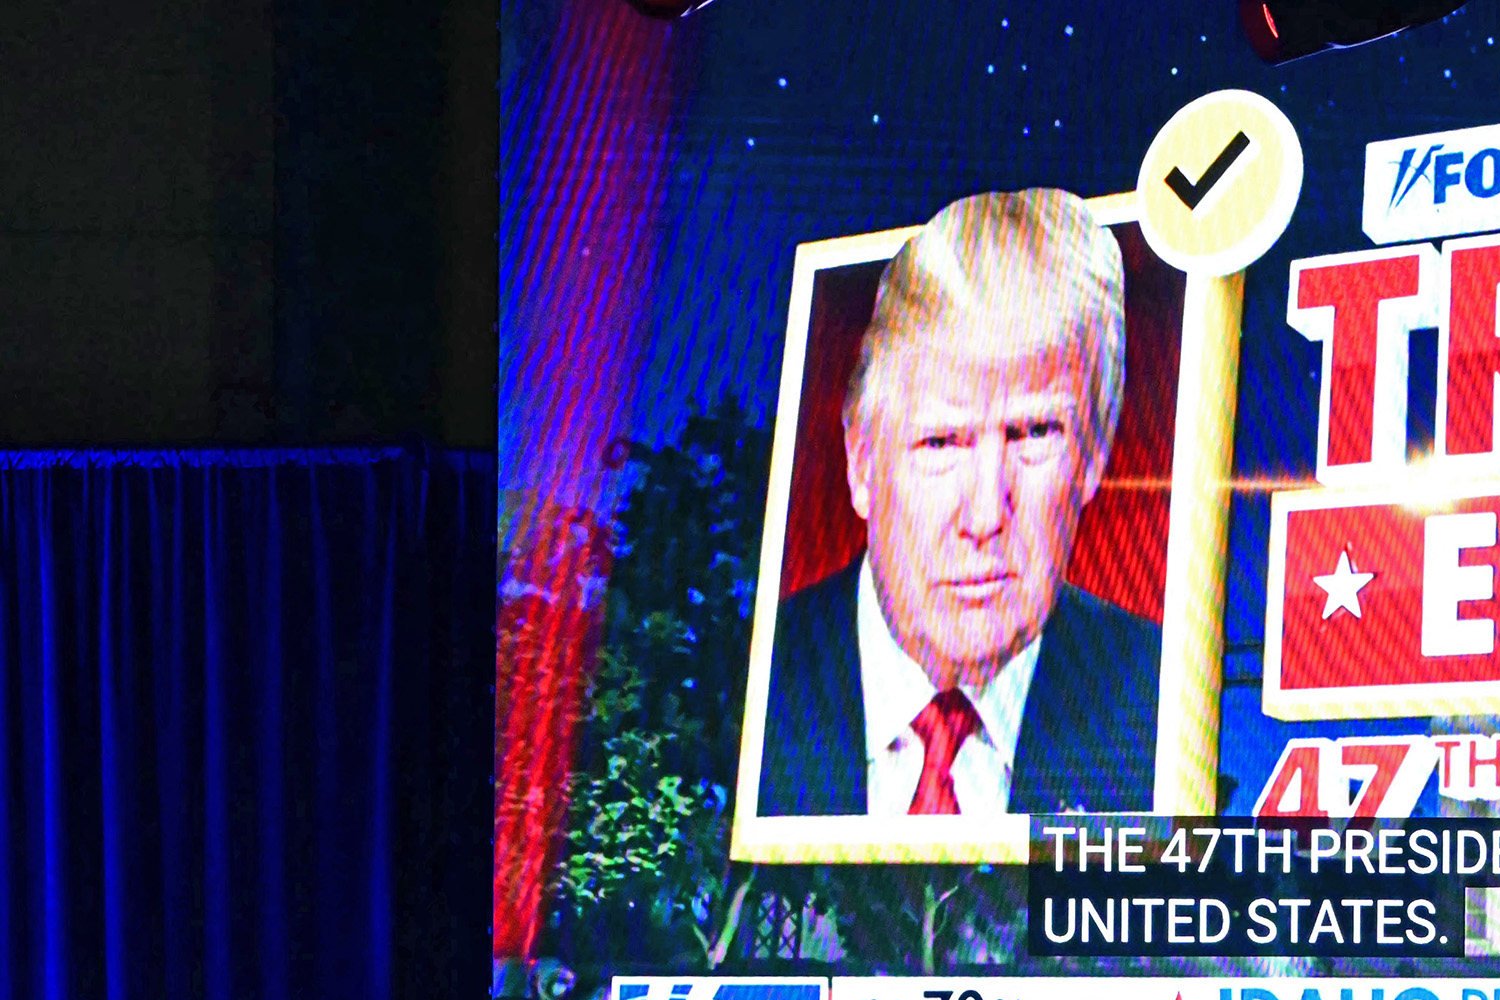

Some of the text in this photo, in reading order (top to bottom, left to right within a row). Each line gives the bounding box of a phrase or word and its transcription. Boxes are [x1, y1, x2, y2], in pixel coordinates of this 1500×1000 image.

[1042, 826, 1147, 873] THE
[1160, 827, 1292, 874] 47TH
[1043, 897, 1450, 945] UNITED STATES.
